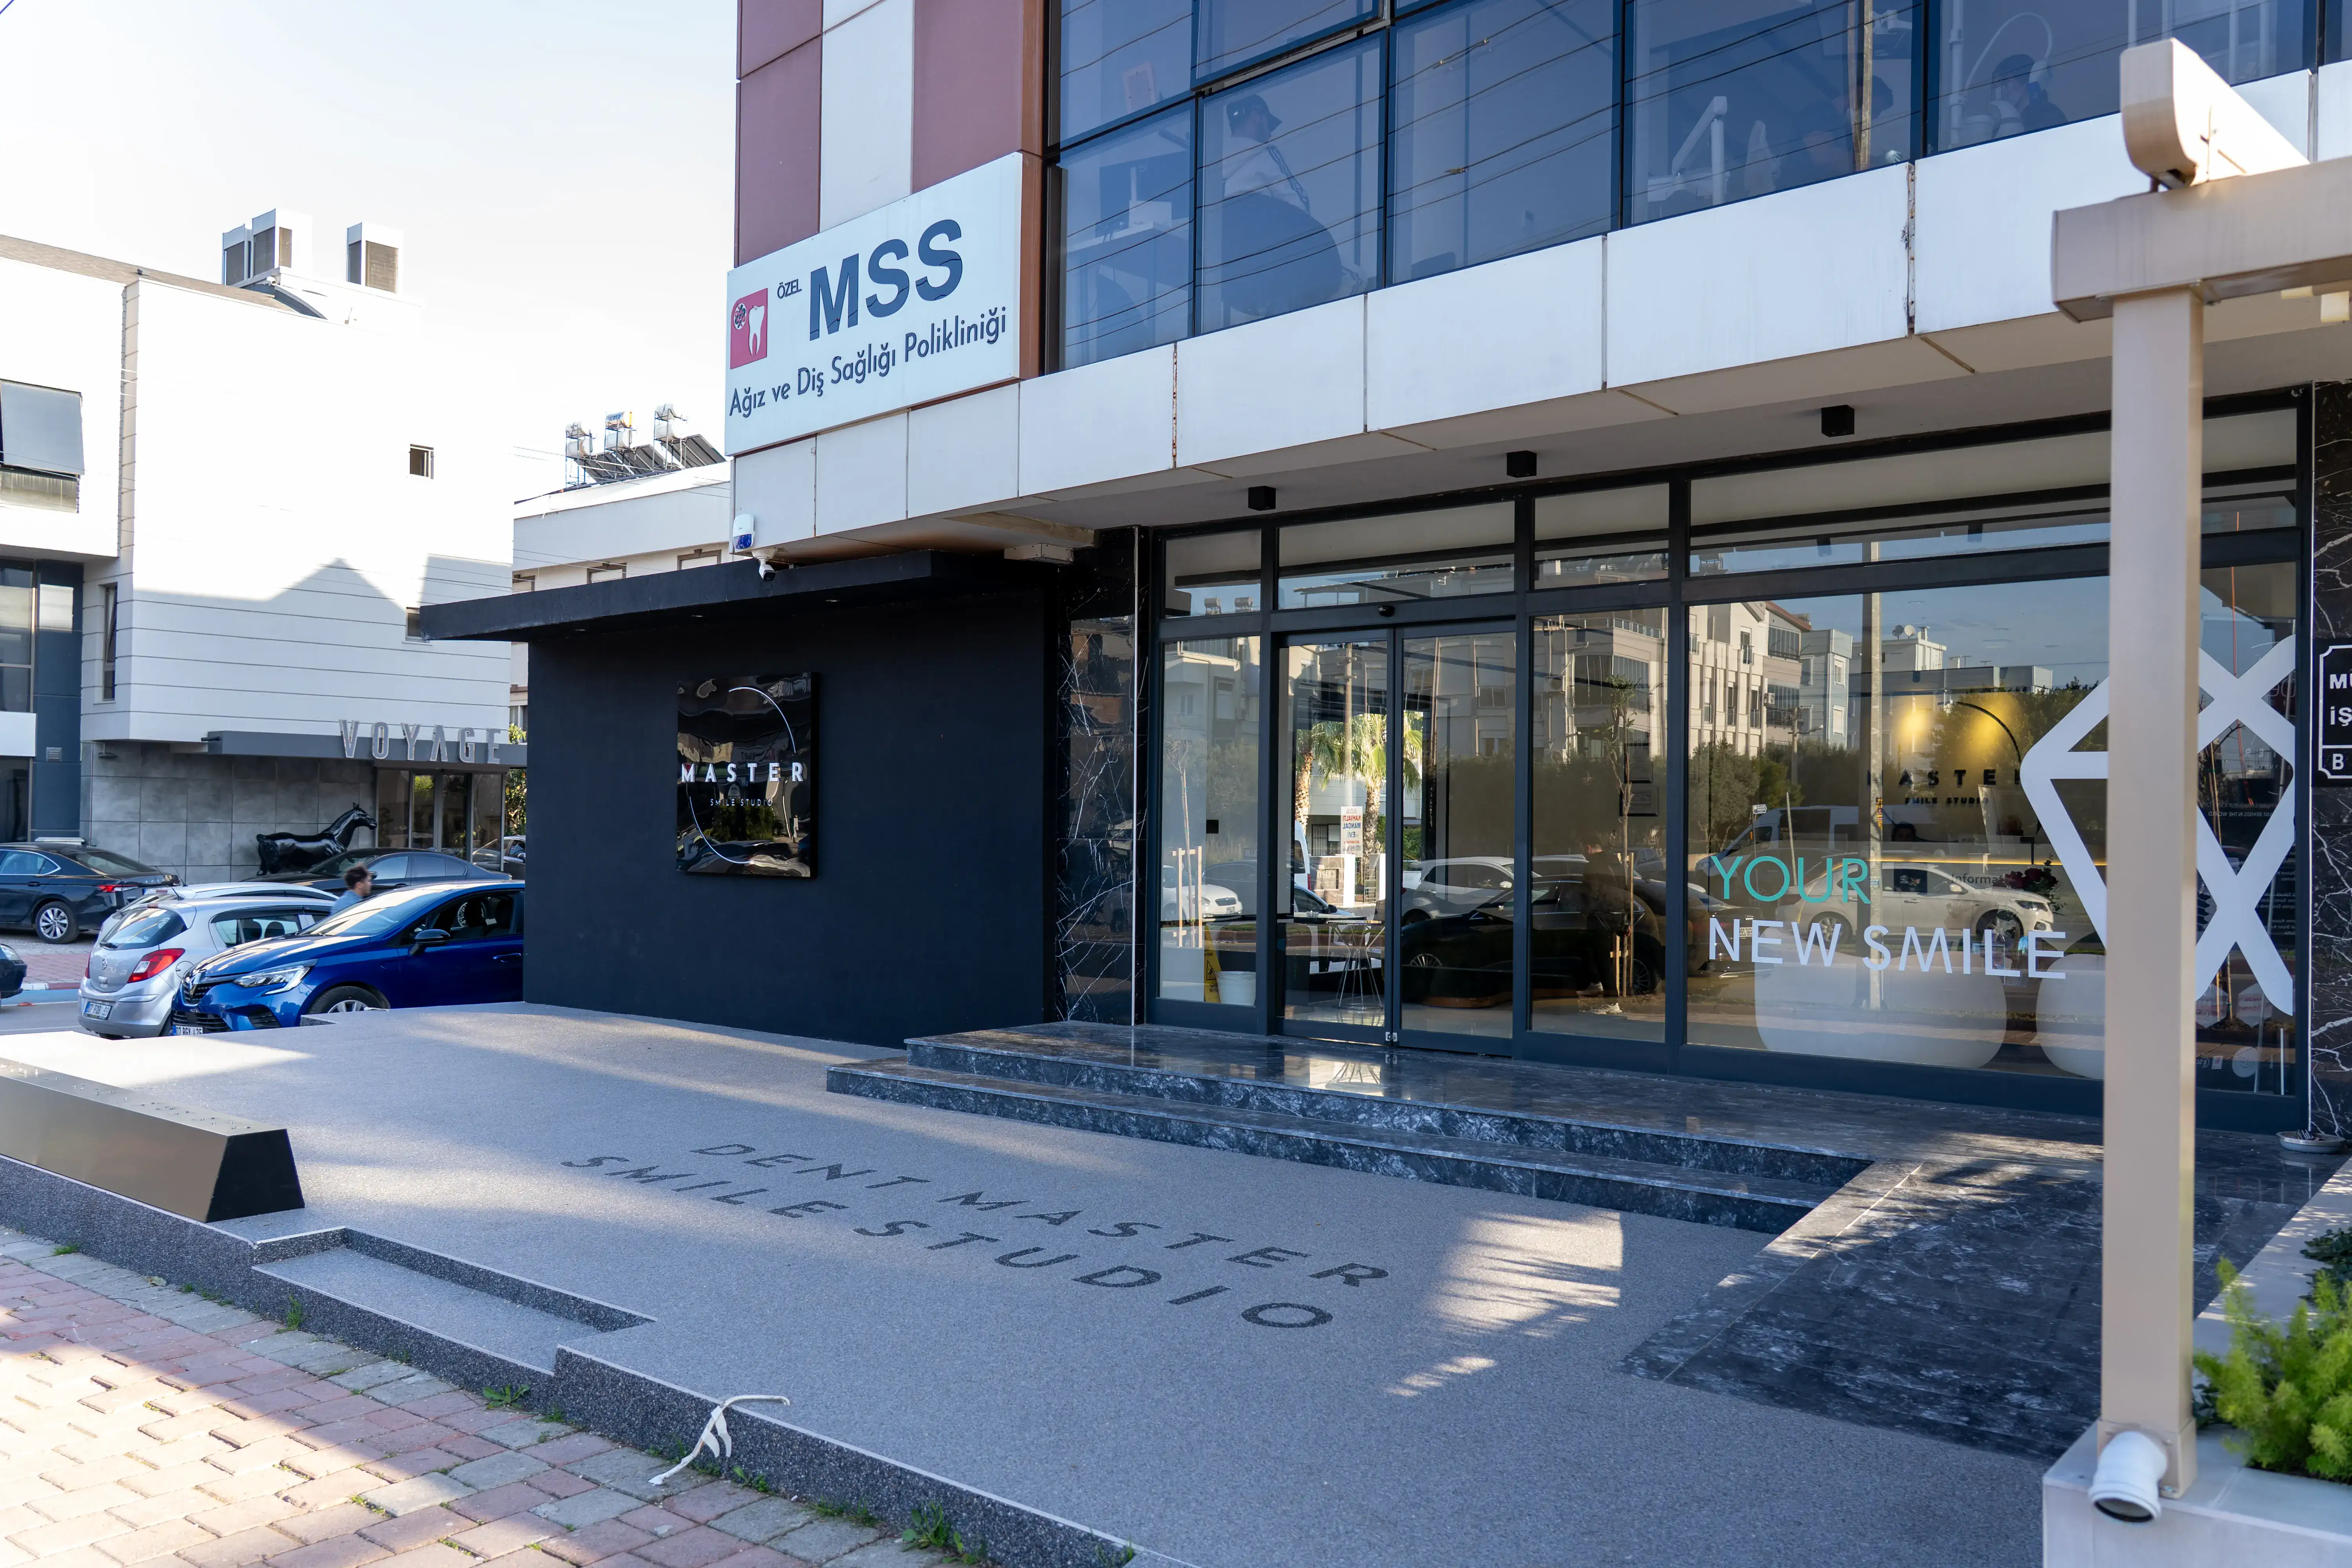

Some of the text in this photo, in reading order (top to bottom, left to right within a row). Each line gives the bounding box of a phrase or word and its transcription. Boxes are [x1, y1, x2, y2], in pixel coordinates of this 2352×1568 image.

[777, 279, 802, 299] ÖZEL
[809, 219, 963, 341] MSS
[730, 307, 1006, 418] Ağız ve Diş Sağlığı Polikliniği
[339, 719, 502, 764] VOYAGE
[681, 762, 804, 782] MASTER
[710, 798, 773, 806] SMILE STUDIO
[1710, 856, 1871, 904] YOUR
[1709, 917, 2066, 980] NEW SMILE
[561, 1155, 1334, 1328] SMILE STUDIO
[690, 1143, 1390, 1287] DENT MASTER
